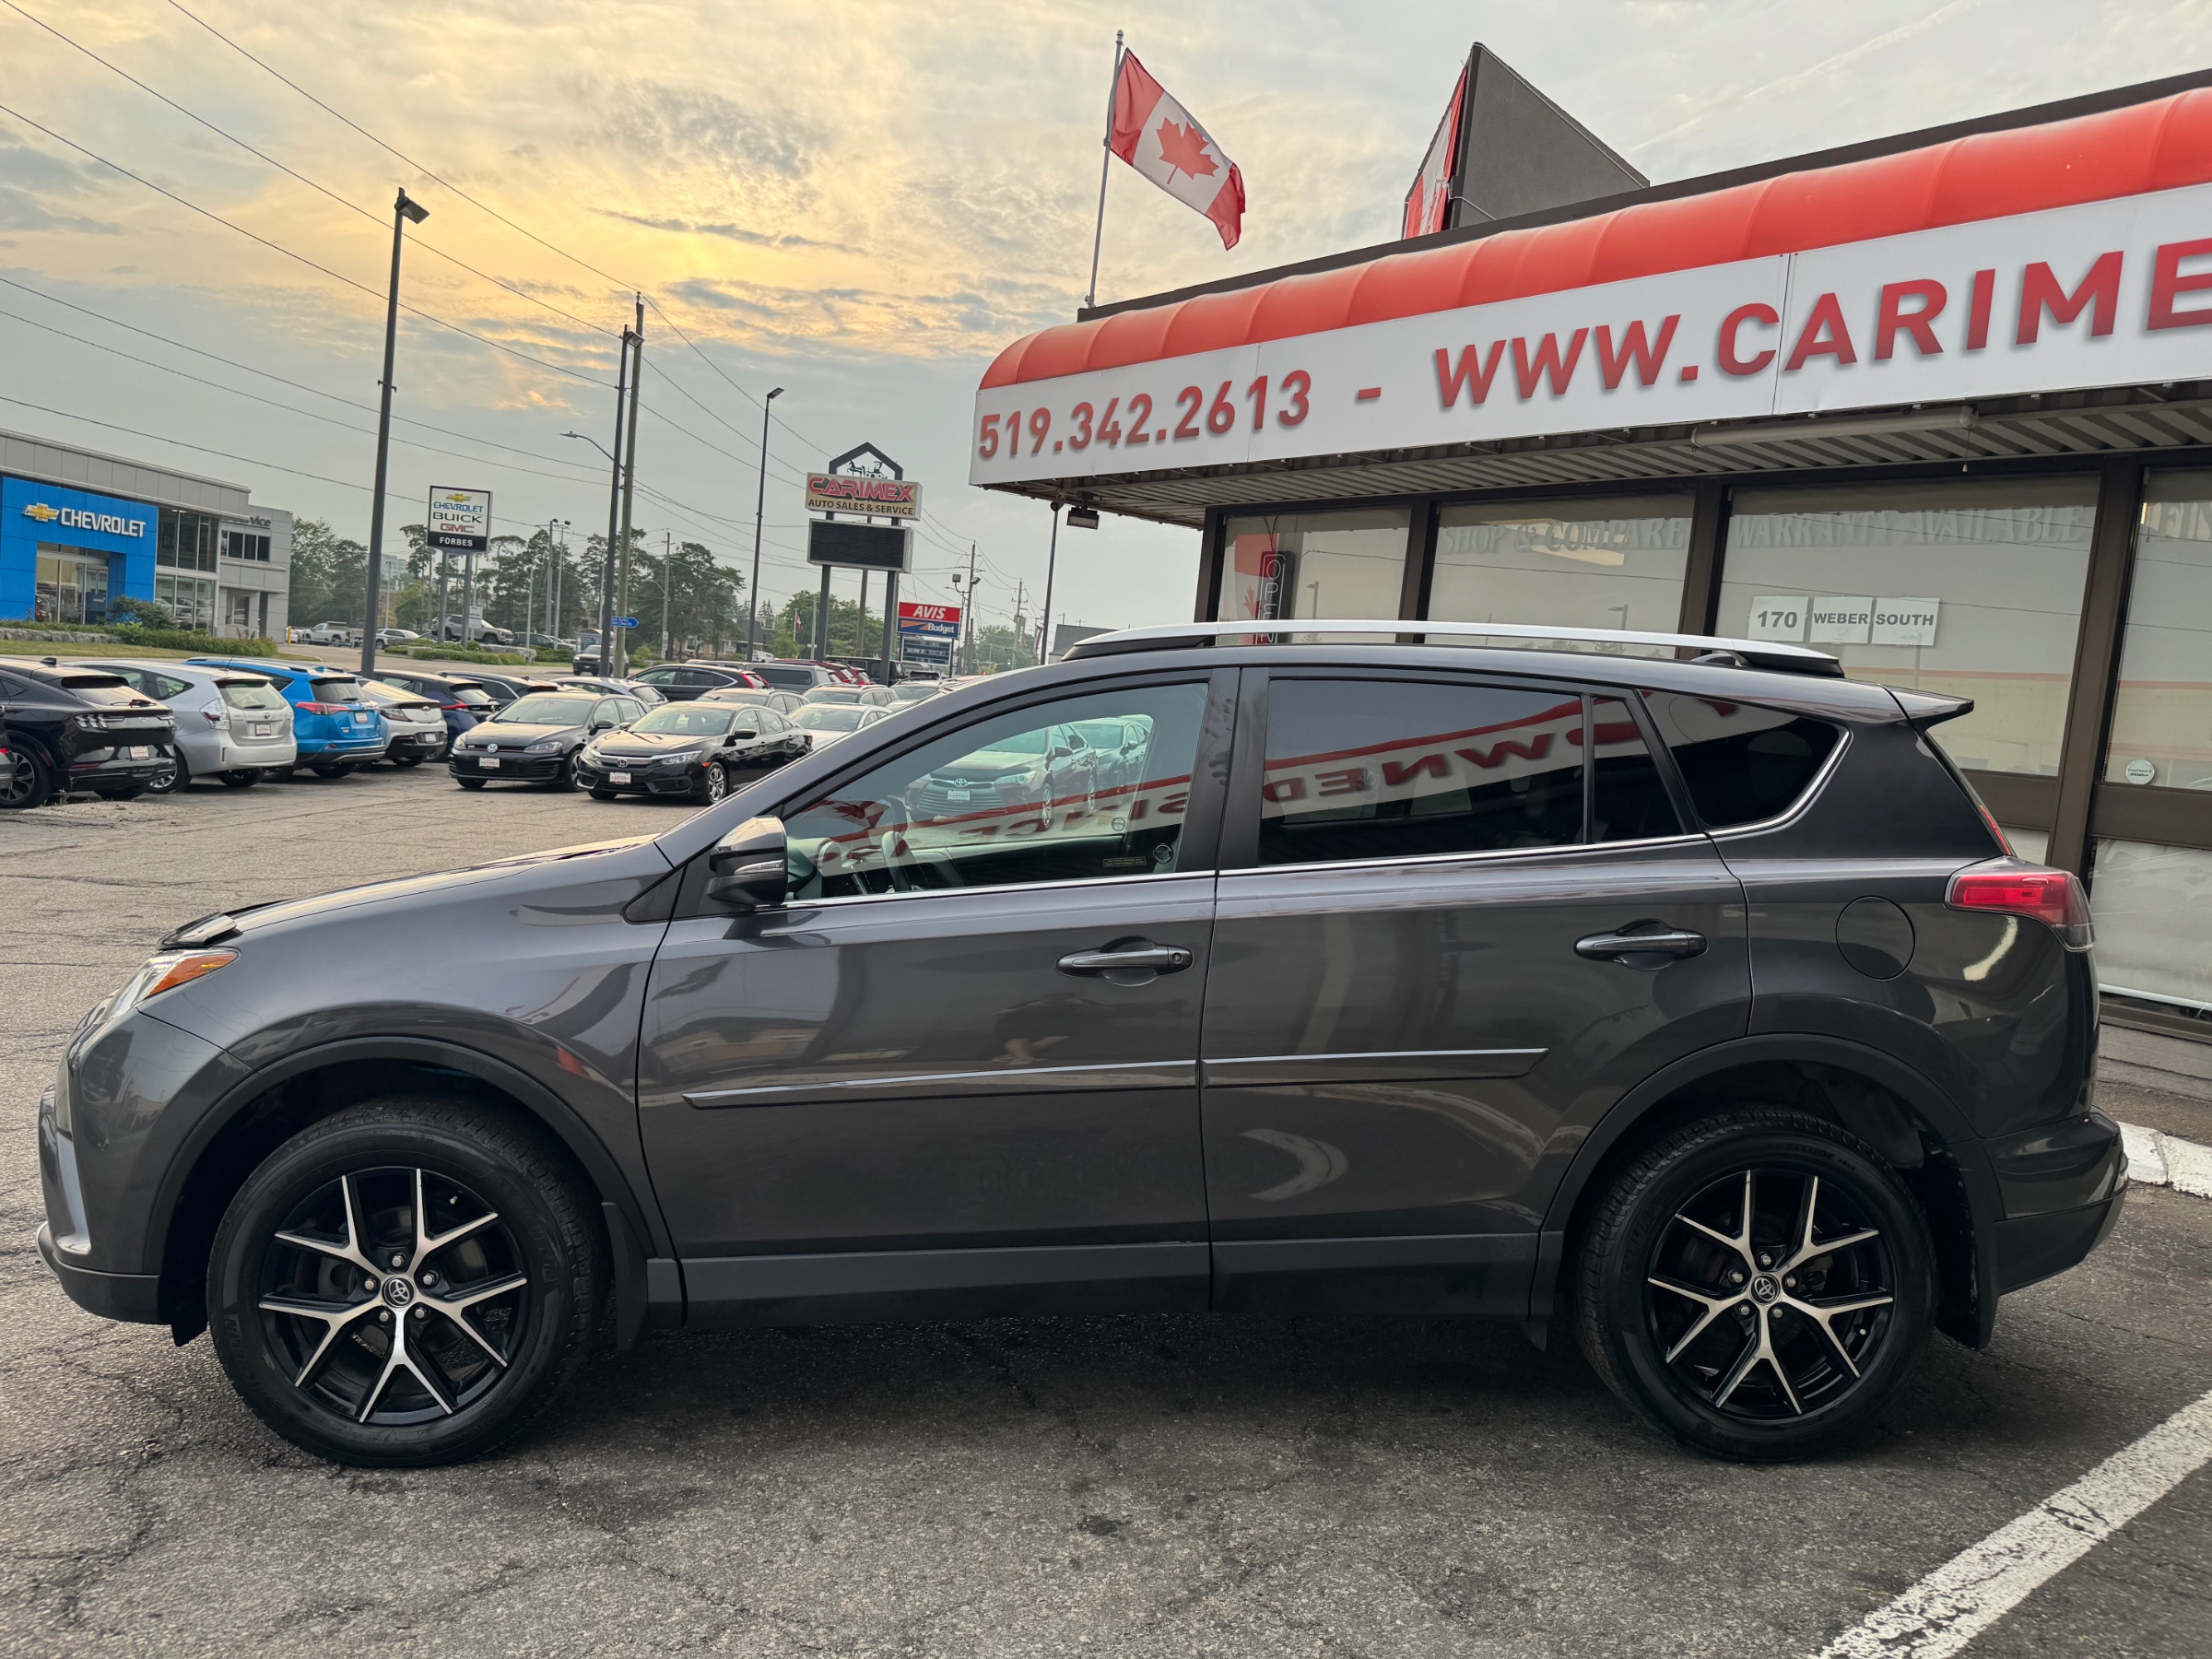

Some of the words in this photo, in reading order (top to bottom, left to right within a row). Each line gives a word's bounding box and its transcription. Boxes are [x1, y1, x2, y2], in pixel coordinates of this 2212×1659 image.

[980, 370, 1312, 458] 519.342.2613
[1435, 238, 2212, 408] WWW.CARIME
[808, 477, 915, 502] CARIMEX
[434, 501, 484, 512] CHEVROLET
[808, 499, 834, 508] AUTO
[836, 501, 865, 512] SALES
[876, 504, 913, 515] SERVICE
[61, 507, 147, 537] CHEVROLET
[433, 512, 483, 524] BUICK
[441, 524, 475, 533] GMC
[440, 537, 473, 547] FORBES
[1443, 526, 1507, 554] SHOP
[1546, 518, 1687, 552] COMPARE
[913, 606, 946, 619] AVIS
[1758, 610, 1798, 628] 170
[1814, 613, 1869, 625] WEBER
[1875, 614, 1935, 626] SOUTH
[928, 622, 955, 634] Budget
